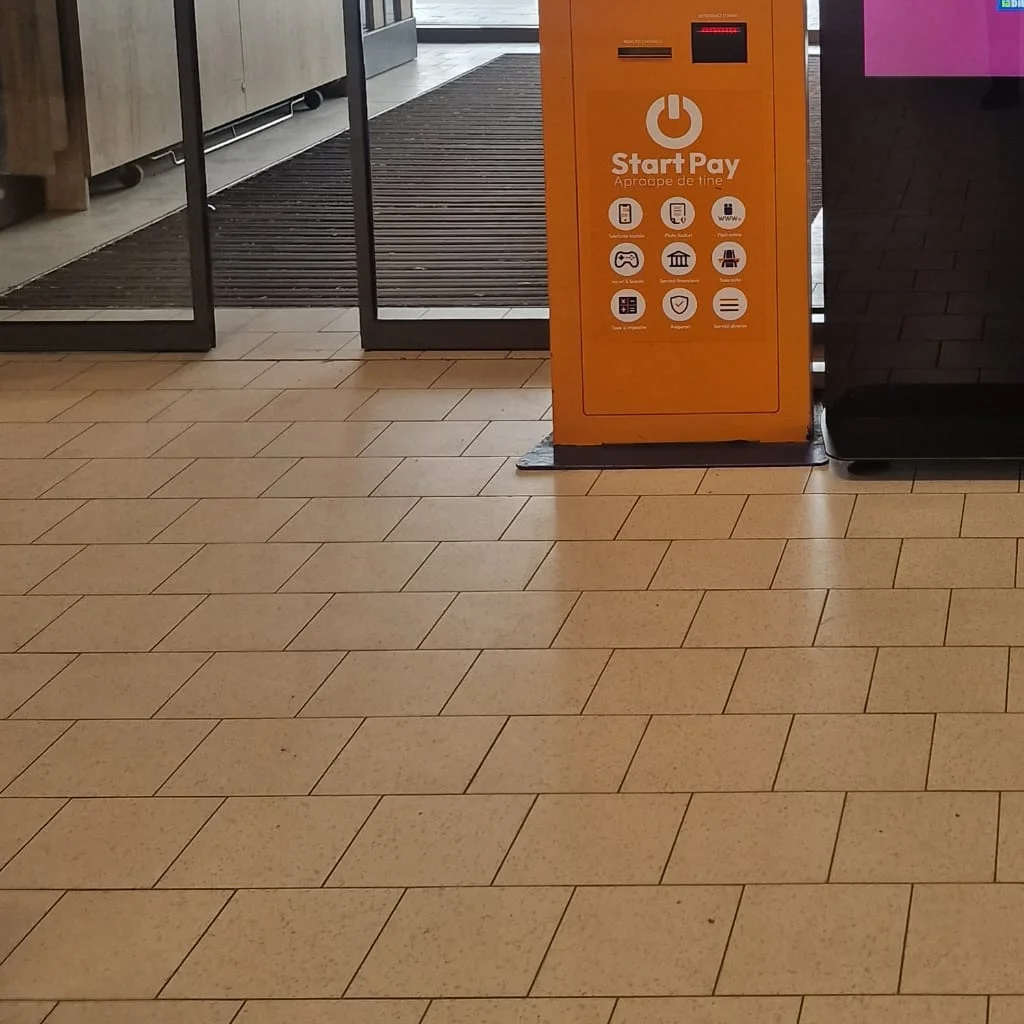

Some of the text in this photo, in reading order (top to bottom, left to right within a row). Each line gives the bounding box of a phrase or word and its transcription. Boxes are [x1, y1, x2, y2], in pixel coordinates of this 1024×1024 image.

[613, 175, 724, 189] Aproape de tine
